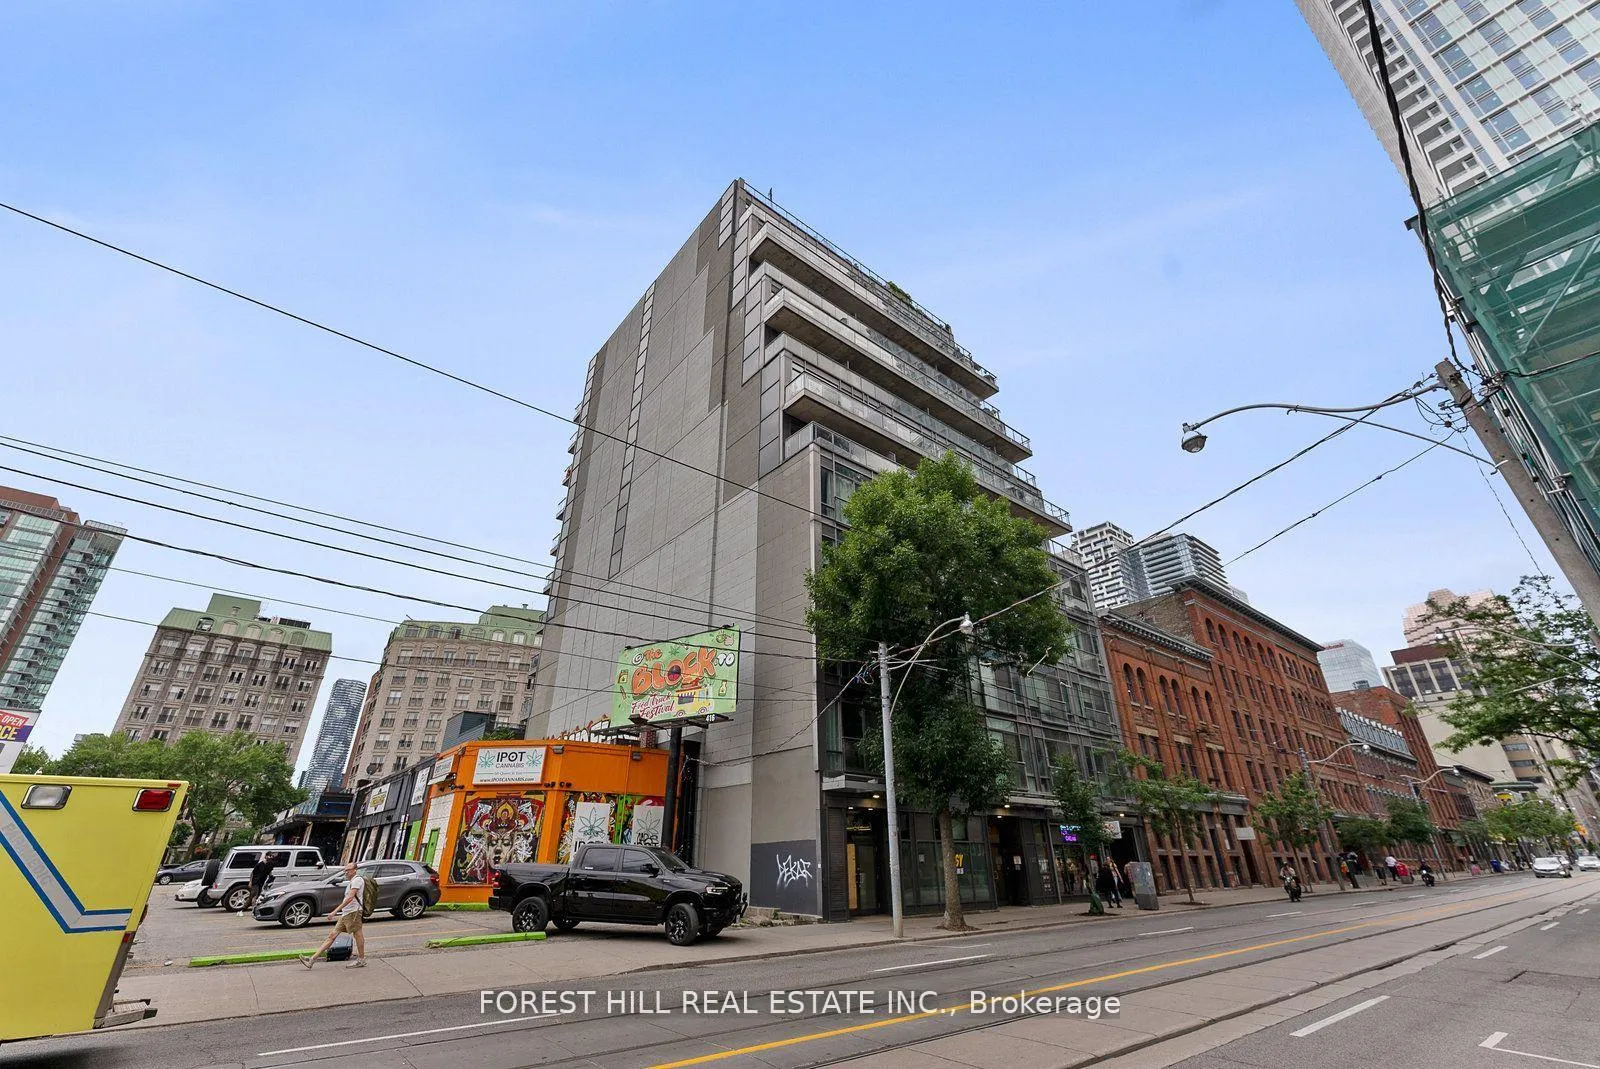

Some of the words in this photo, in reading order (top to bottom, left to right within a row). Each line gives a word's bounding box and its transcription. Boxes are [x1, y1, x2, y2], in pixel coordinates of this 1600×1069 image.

[631, 647, 717, 697] BLOCK
[631, 699, 651, 713] Food
[650, 691, 671, 706] Truck
[639, 700, 675, 719] Festival
[2, 715, 25, 726] OPEN
[0, 725, 17, 740] CE
[496, 751, 526, 762] IPOT
